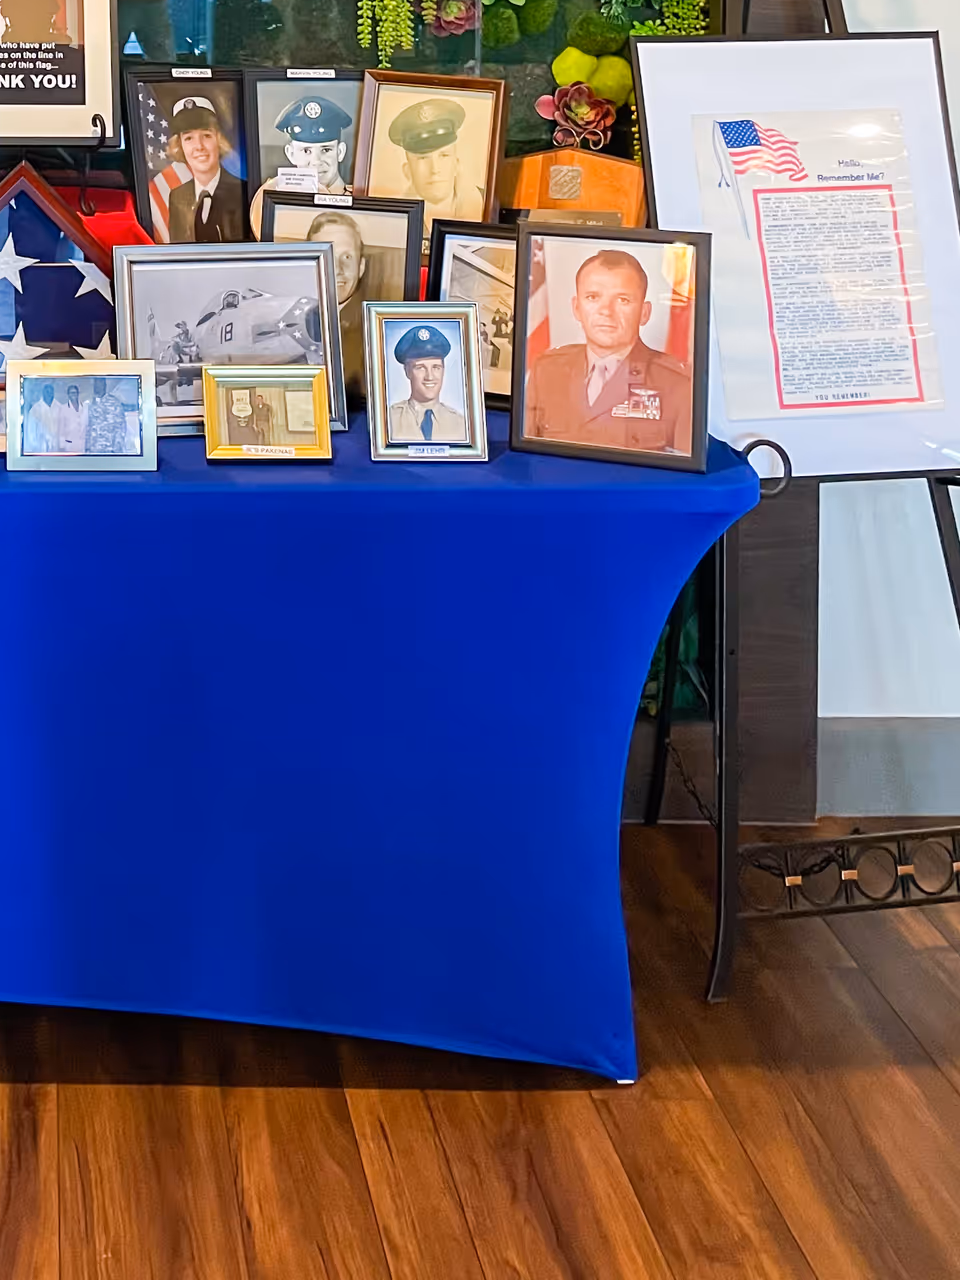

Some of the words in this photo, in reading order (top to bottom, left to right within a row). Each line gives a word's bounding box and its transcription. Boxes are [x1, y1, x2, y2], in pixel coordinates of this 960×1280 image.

[42, 42, 56, 51] put
[23, 51, 37, 59] the
[38, 51, 54, 59] line
[55, 51, 64, 59] in
[8, 61, 17, 69] of
[18, 61, 34, 69] this
[30, 74, 77, 89] YOU!
[837, 159, 864, 168] Hello,
[817, 174, 865, 183] Remember
[866, 172, 885, 181] Me?
[220, 322, 234, 344] 18
